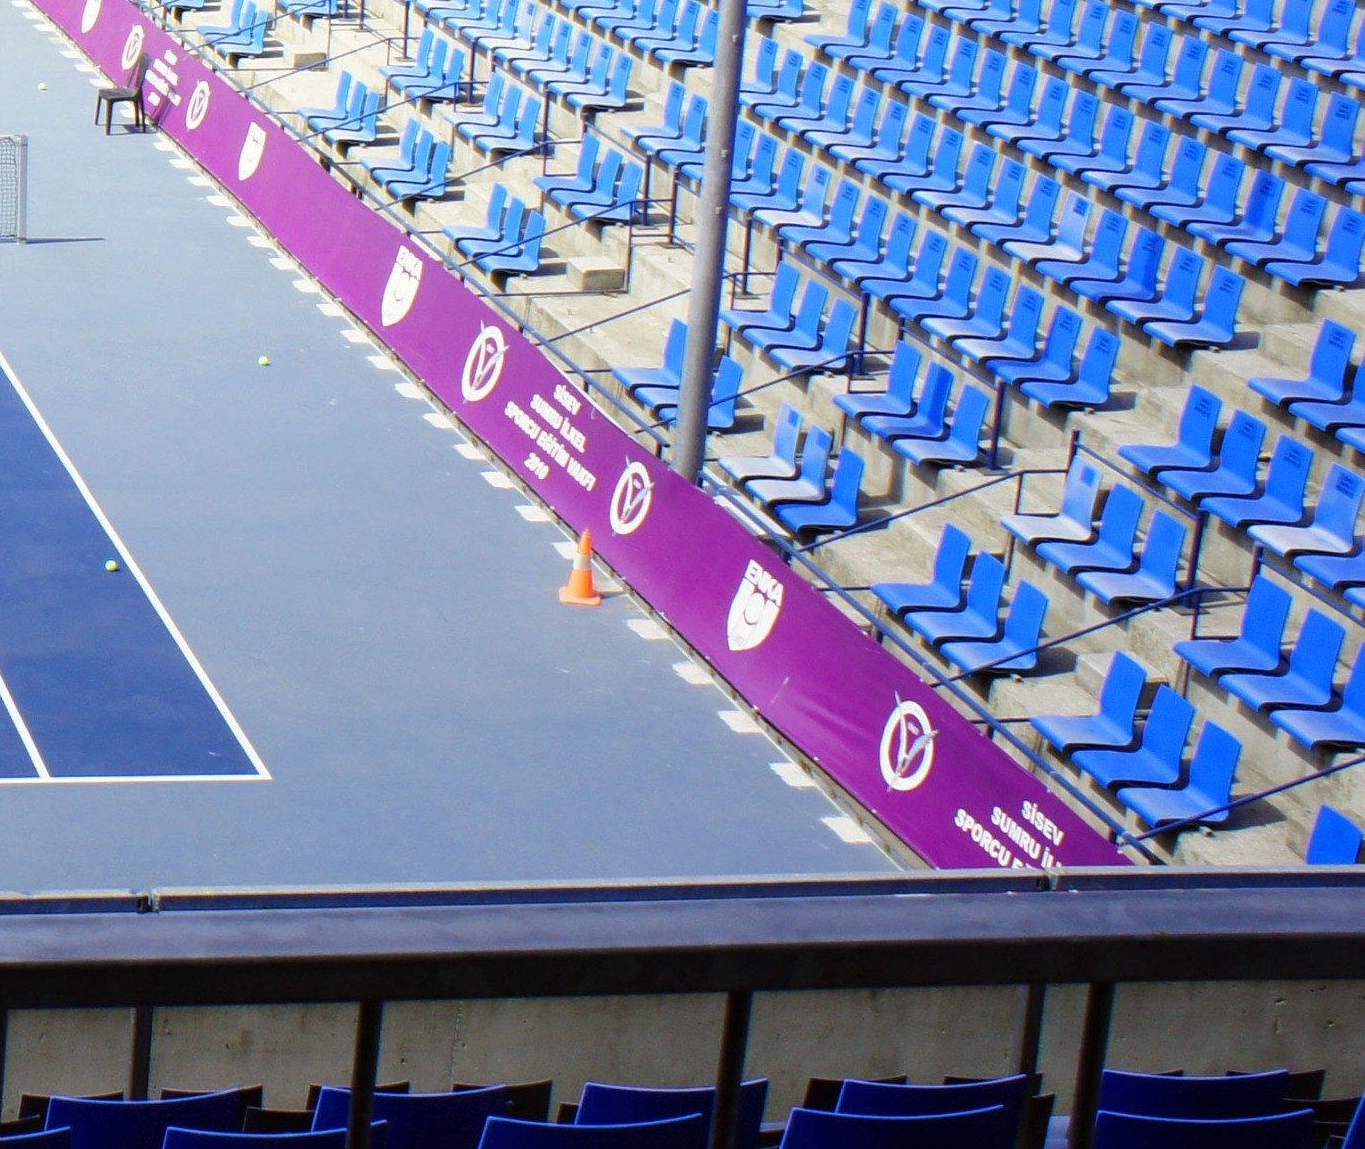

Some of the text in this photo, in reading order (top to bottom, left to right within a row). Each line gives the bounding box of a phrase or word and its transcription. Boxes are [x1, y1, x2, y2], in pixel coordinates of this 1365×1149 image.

[744, 558, 784, 607] ENKA
[954, 808, 1012, 867] SPORCU
[991, 806, 1041, 860] SUMRU
[1021, 800, 1064, 847] SİSEV
